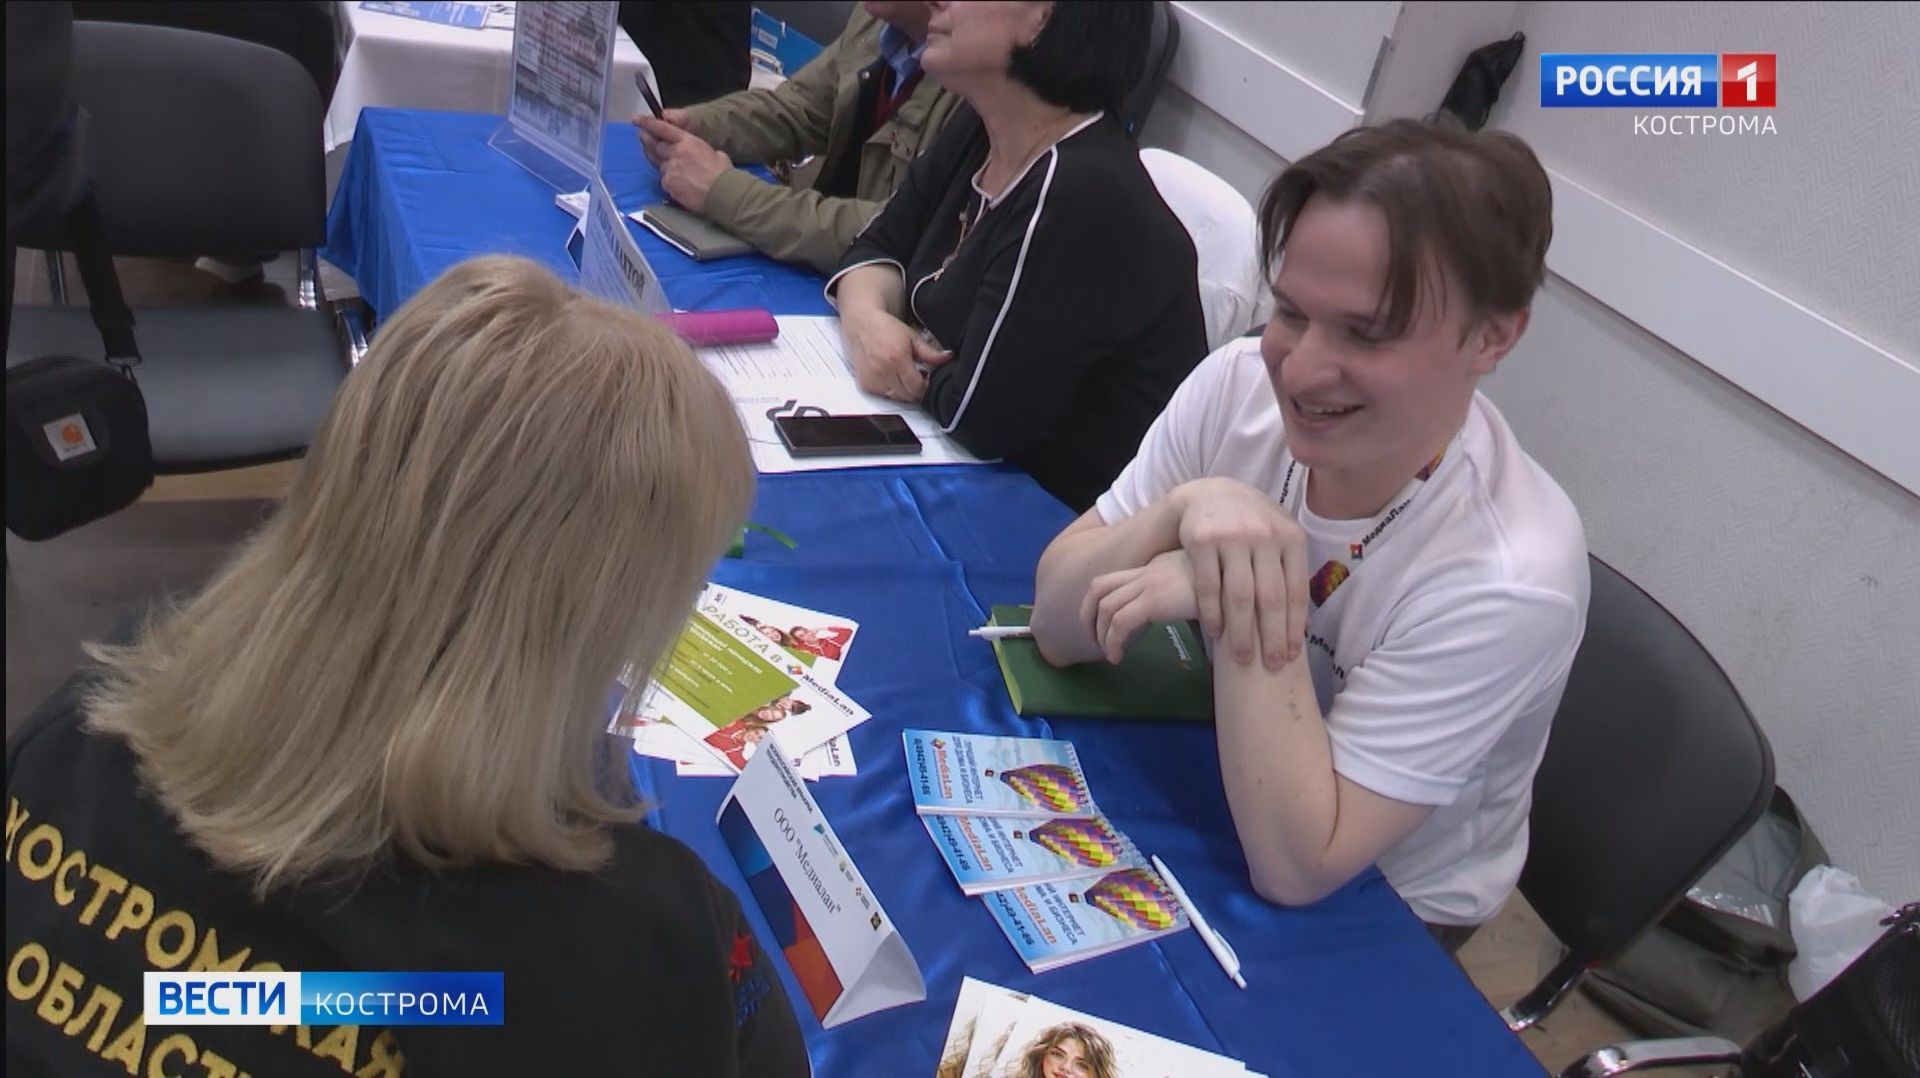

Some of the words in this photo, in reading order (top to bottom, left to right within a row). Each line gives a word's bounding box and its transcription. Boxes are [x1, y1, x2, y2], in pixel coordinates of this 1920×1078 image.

[702, 604, 769, 653] РАБОТА
[802, 674, 854, 715] MediaLan
[938, 749, 953, 799] MediaLan
[774, 807, 796, 842] ООО
[795, 840, 841, 914] "Медиалан"
[1048, 906, 1078, 945] БИЗНЕСА
[1053, 894, 1085, 936] ИНТЕРНЕТ
[6, 942, 252, 1078] ОБЛАСТ
